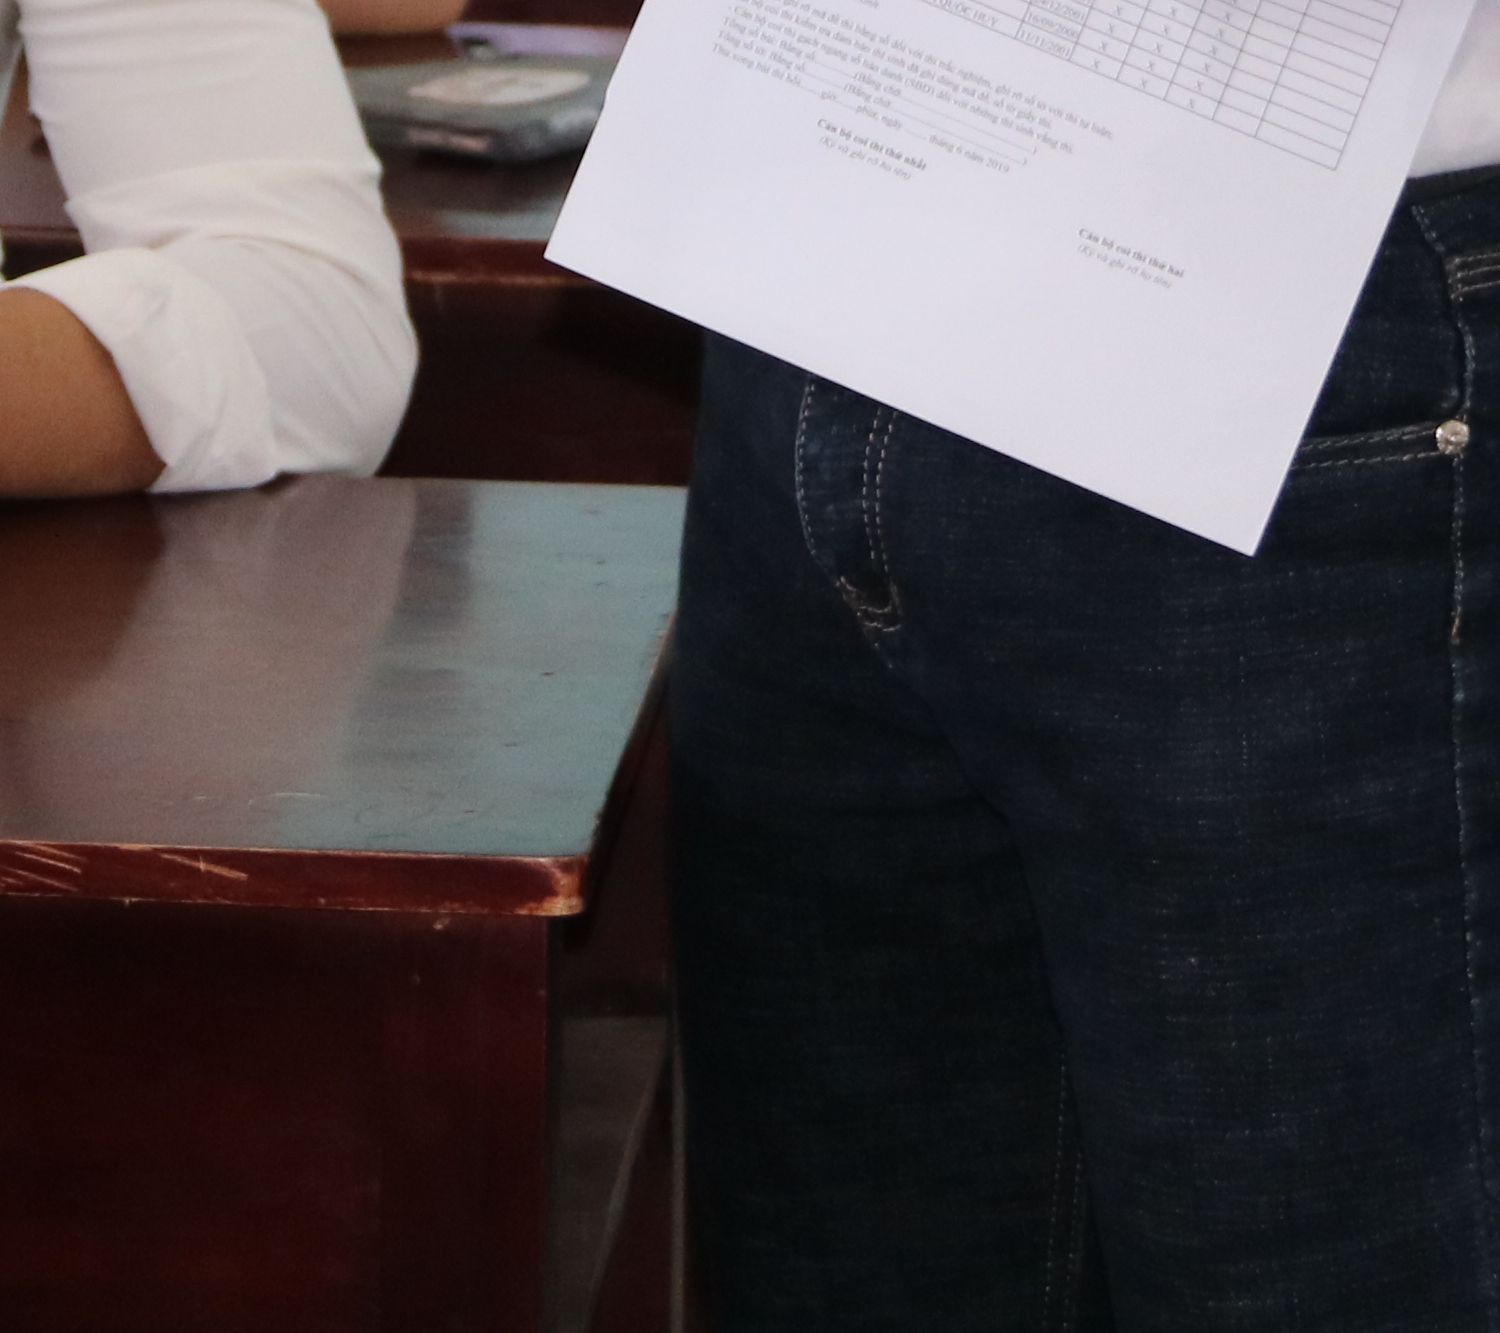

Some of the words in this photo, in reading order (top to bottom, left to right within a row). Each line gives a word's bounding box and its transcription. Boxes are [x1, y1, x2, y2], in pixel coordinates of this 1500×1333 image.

[971, 9, 999, 28] HUY
[837, 126, 853, 142] bộ
[852, 133, 869, 147] coi
[868, 139, 885, 154] thi
[984, 157, 1010, 175] 2019
[1166, 264, 1185, 279] hai
